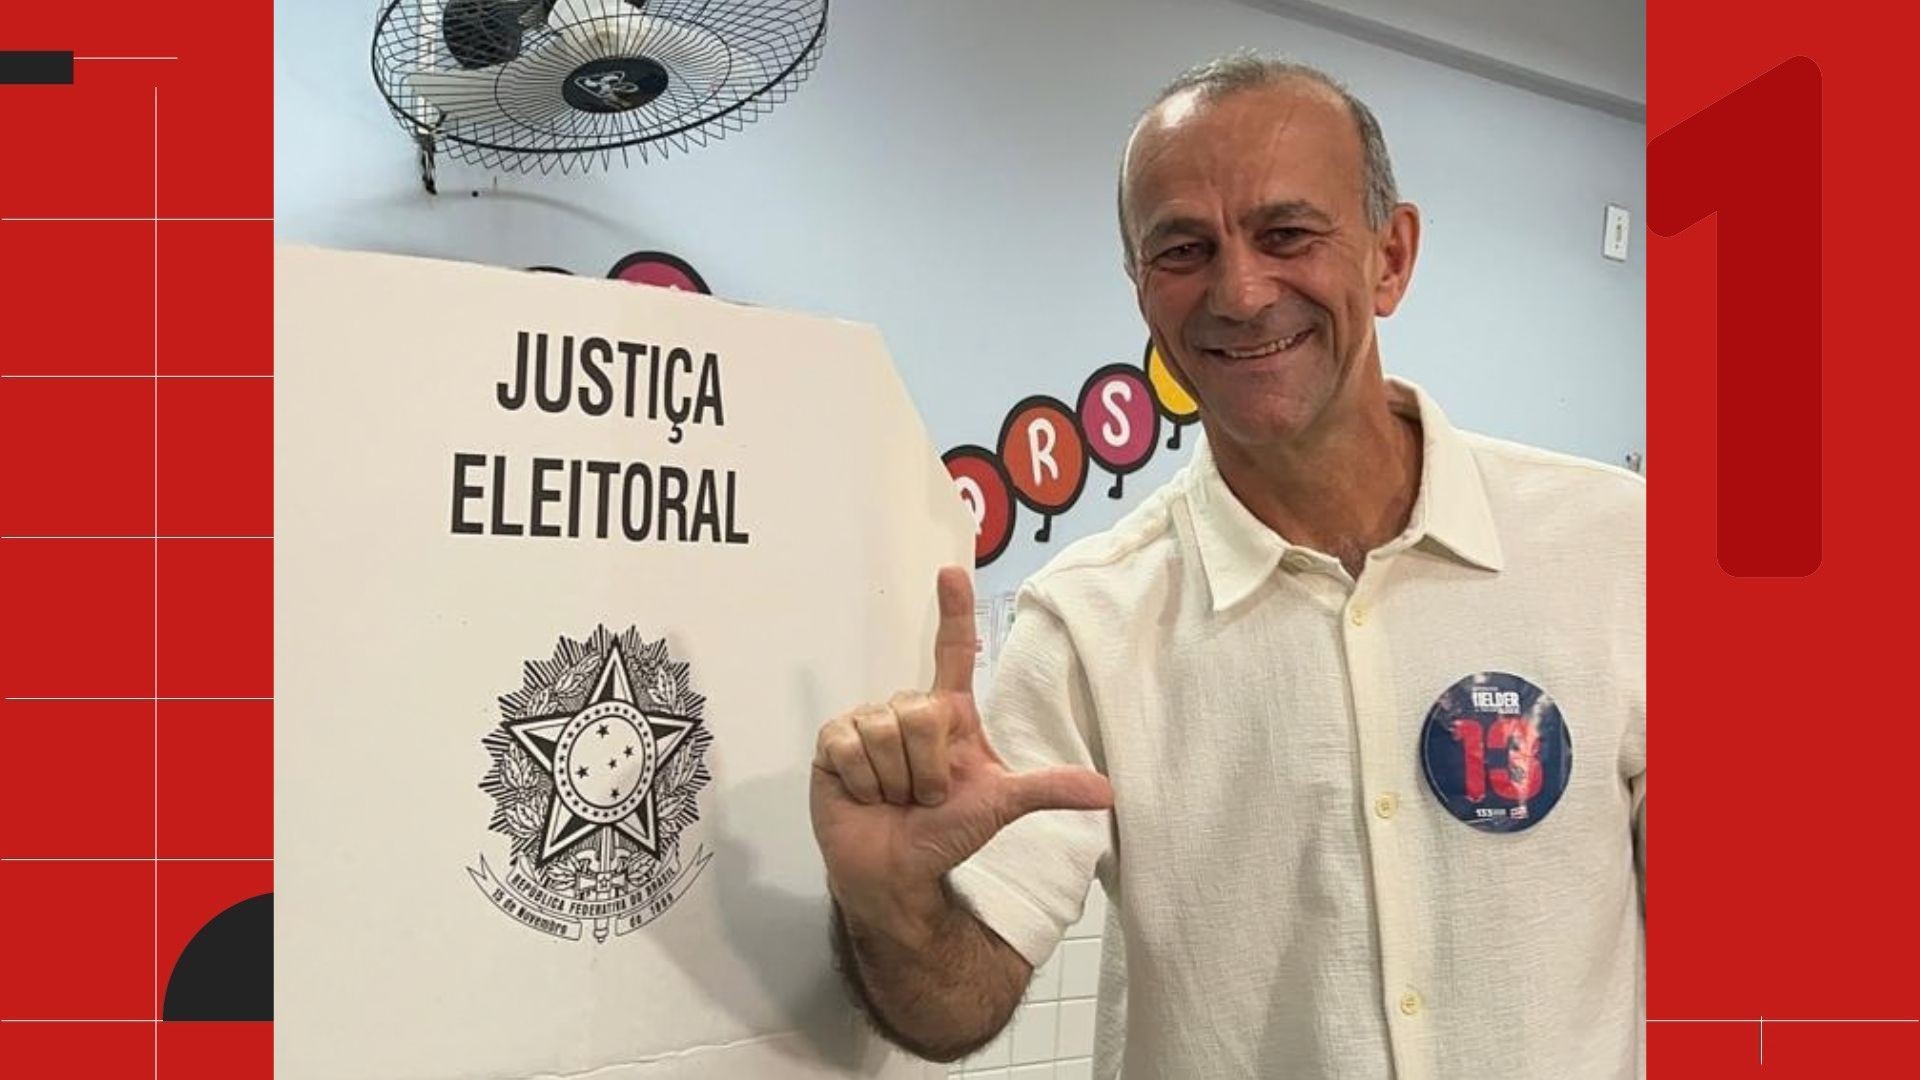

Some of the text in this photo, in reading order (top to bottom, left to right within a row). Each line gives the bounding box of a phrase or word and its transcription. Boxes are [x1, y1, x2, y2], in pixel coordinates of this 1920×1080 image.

[496, 331, 724, 444] JUSTIÇA
[451, 452, 749, 544] ELEITORAL
[1451, 716, 1543, 803] 13
[568, 898, 627, 917] FEDERATIVA
[630, 891, 642, 906] DO
[645, 867, 675, 897] BRASIL
